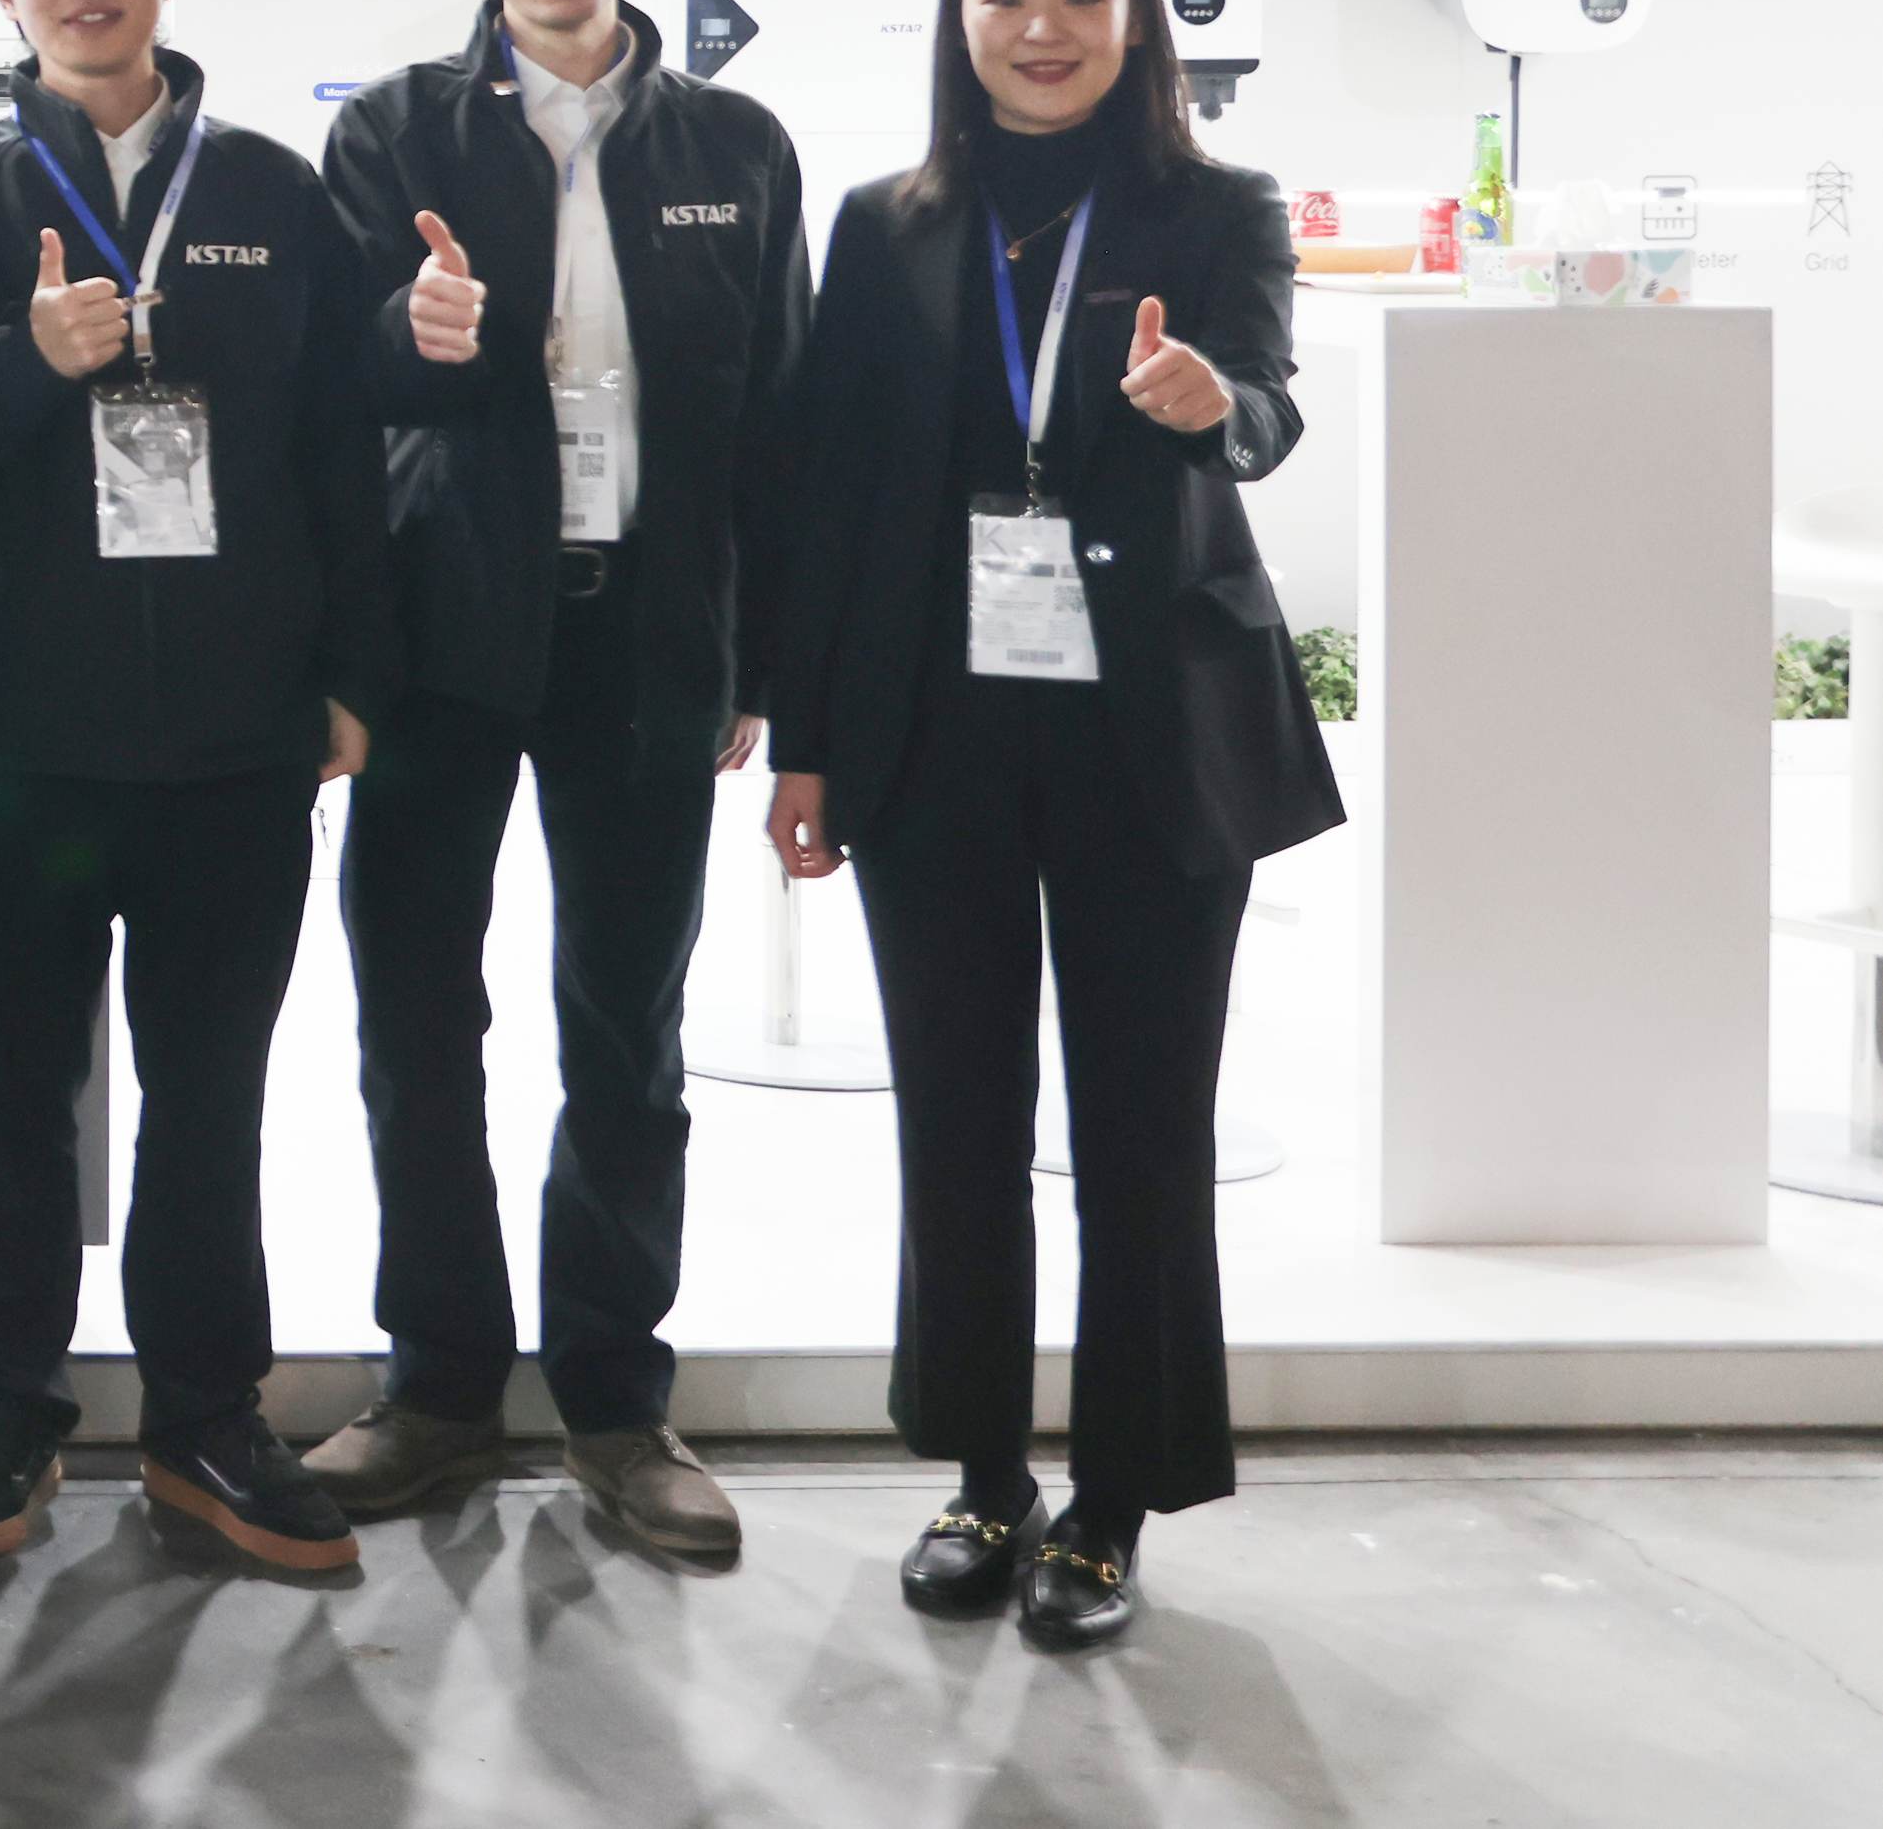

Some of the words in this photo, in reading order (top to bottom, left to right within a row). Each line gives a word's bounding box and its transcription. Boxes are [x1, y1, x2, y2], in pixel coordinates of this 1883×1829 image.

[661, 202, 739, 226] KSTAR
[185, 243, 270, 266] KSTAR
[1692, 251, 1738, 269] eter
